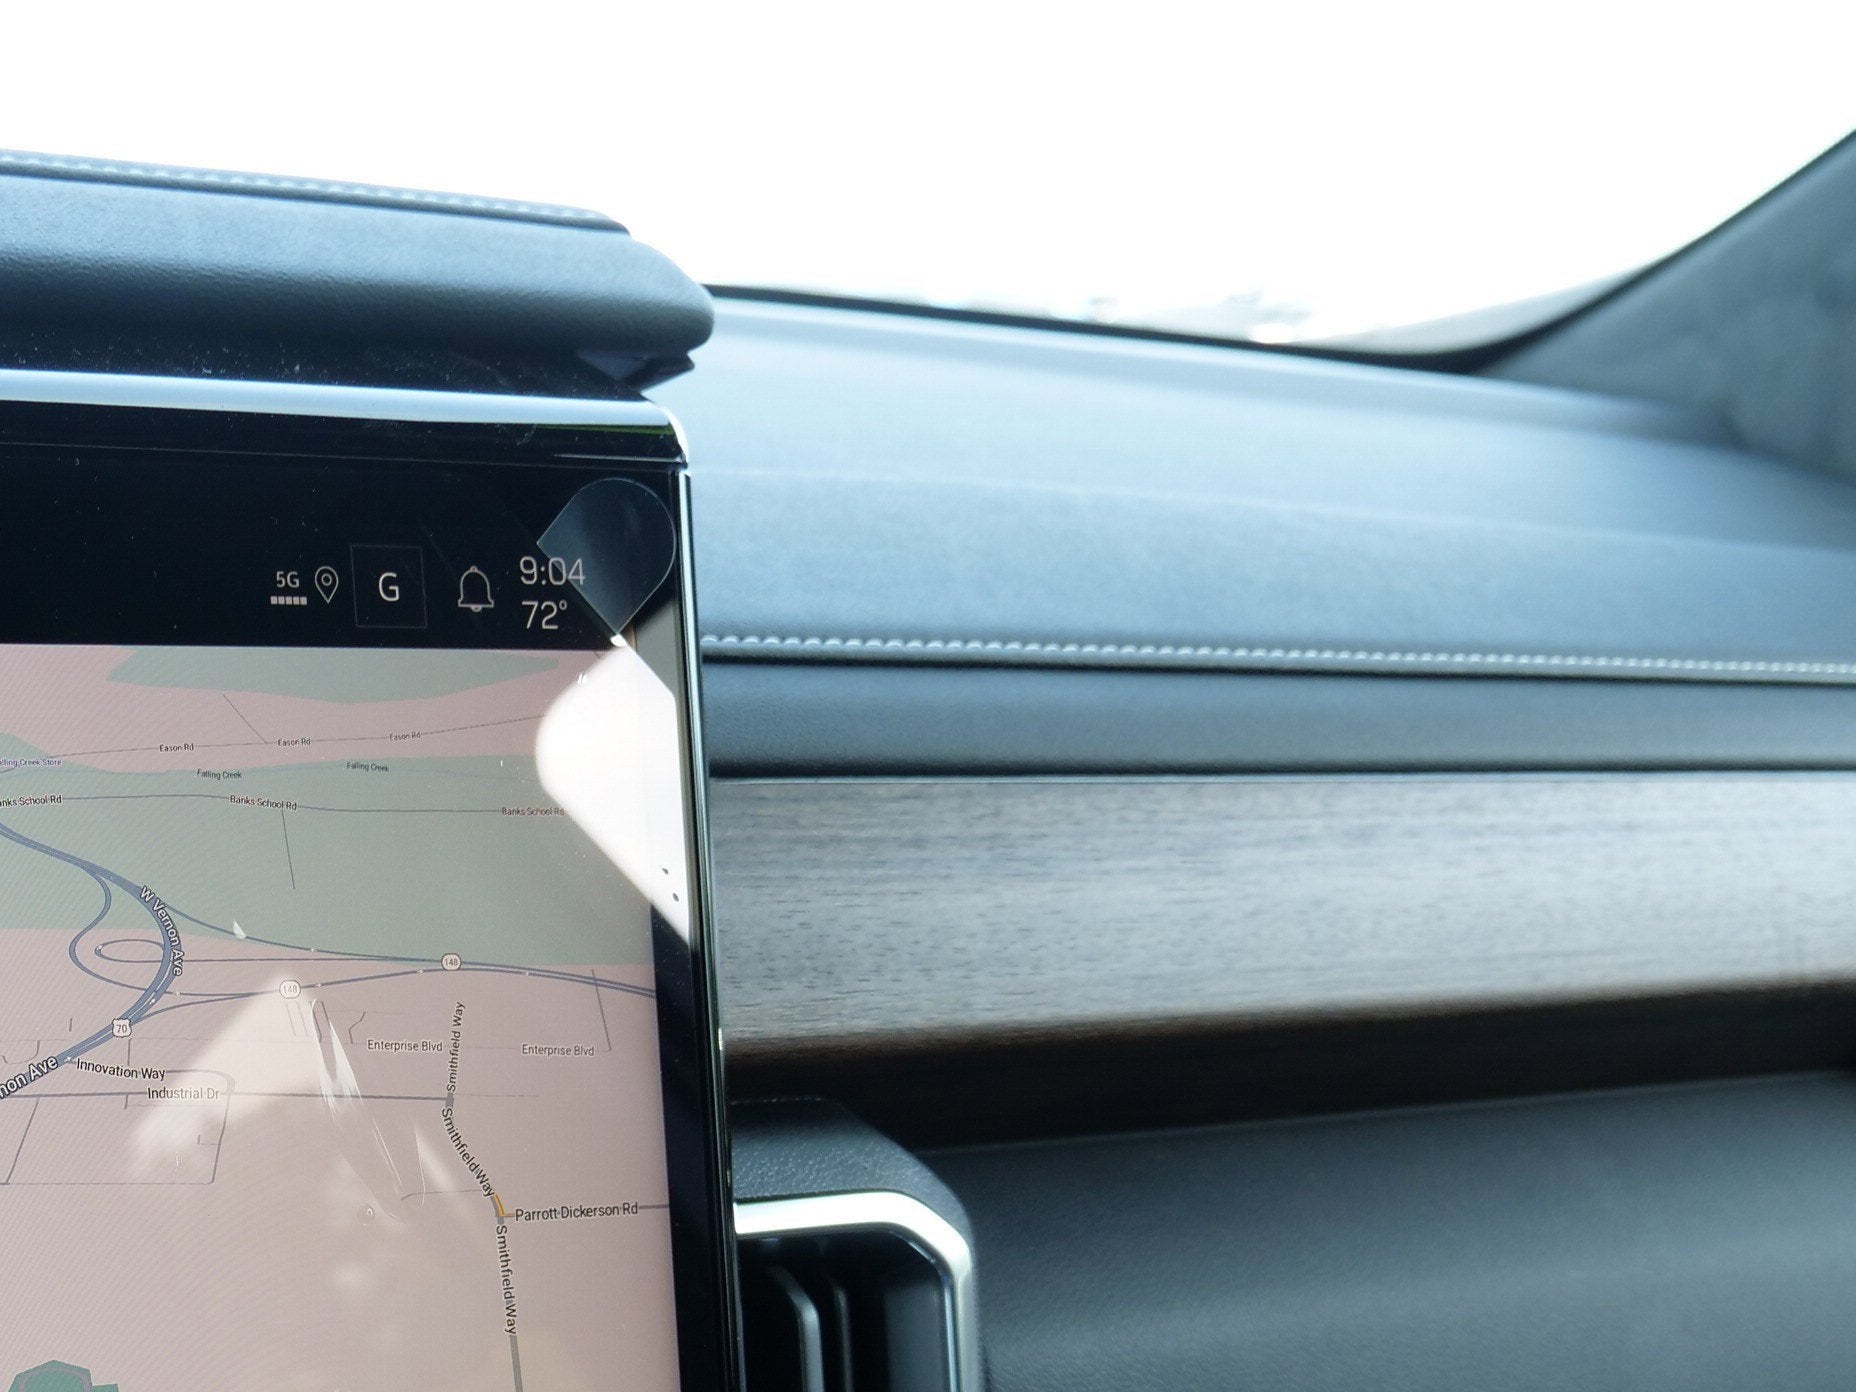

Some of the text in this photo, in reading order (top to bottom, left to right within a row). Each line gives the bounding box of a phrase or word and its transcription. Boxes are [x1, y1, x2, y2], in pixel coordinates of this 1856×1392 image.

[276, 571, 300, 588] 5G
[520, 557, 586, 587] 9:04
[378, 573, 400, 601] G
[522, 600, 568, 629] 72°
[277, 738, 311, 747] Eason Rd
[389, 731, 422, 741] Eason Rd
[159, 743, 194, 752] Eason Rd
[222, 771, 242, 779] Creek
[19, 796, 48, 806] School
[50, 795, 62, 805] Rd
[230, 796, 297, 811] Banks School Rd
[501, 807, 526, 816] Banks
[528, 807, 552, 816] School
[140, 886, 185, 976] W Vernon Ave
[444, 957, 459, 968] 148
[282, 984, 298, 995] 148
[116, 1024, 127, 1035] 70
[368, 1039, 443, 1054] Enterprise Blvd
[447, 1002, 465, 1092] Smithfield Way
[522, 1044, 595, 1058] Enterprise Blvd
[26, 1055, 58, 1084] Ave
[77, 1058, 166, 1081] Innovation Way
[147, 1087, 221, 1099] Industrial Dr
[442, 1108, 495, 1197] Smithfield Way
[515, 1202, 638, 1222] Parrott Dickerson Rd
[496, 1225, 517, 1335] Smithfield Way
